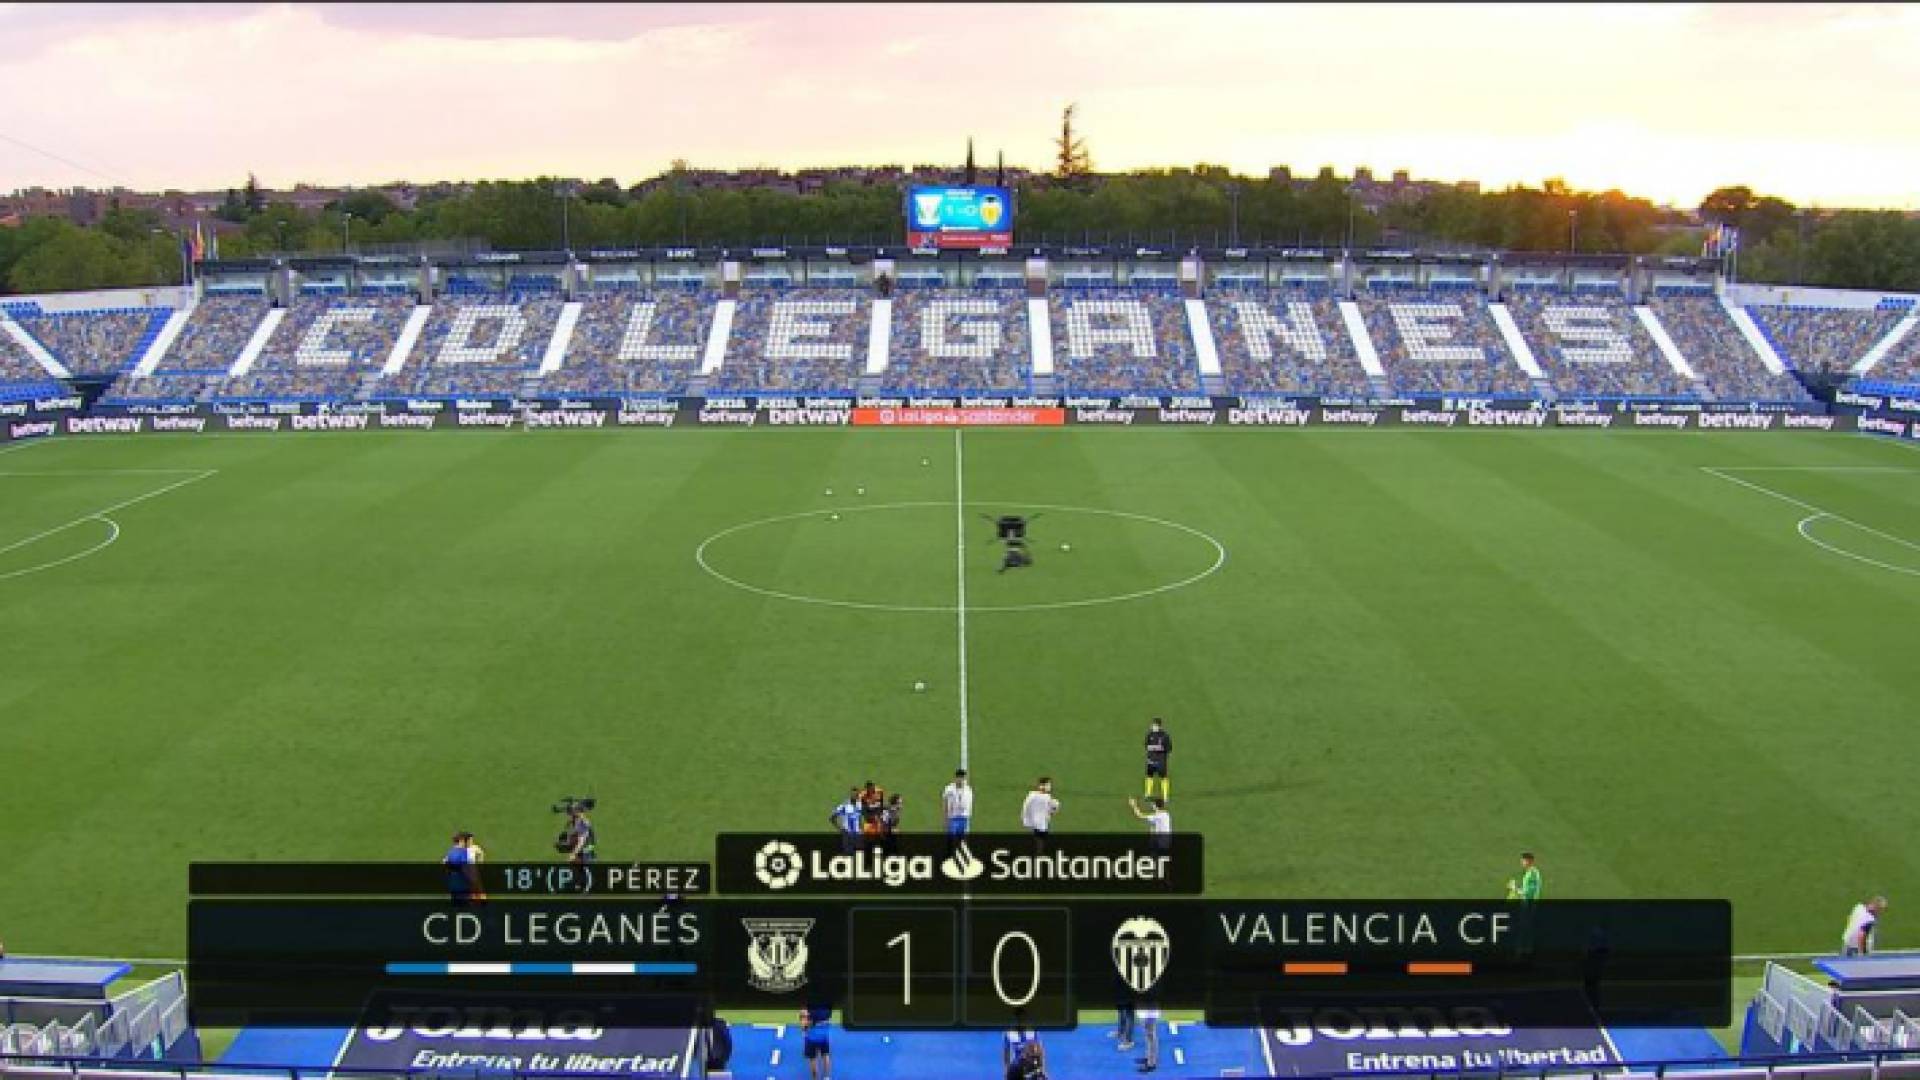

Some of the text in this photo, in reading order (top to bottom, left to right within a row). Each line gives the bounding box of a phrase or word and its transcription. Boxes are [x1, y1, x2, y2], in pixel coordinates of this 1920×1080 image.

[68, 418, 142, 432] betway
[291, 414, 368, 430] betway
[526, 410, 605, 427] betway
[769, 409, 849, 425] betway
[1228, 408, 1310, 426] betway
[1468, 410, 1548, 427] betway
[1698, 412, 1773, 430] betway
[1346, 1052, 1457, 1070] Entrena
[1463, 1049, 1493, 1068] tu
